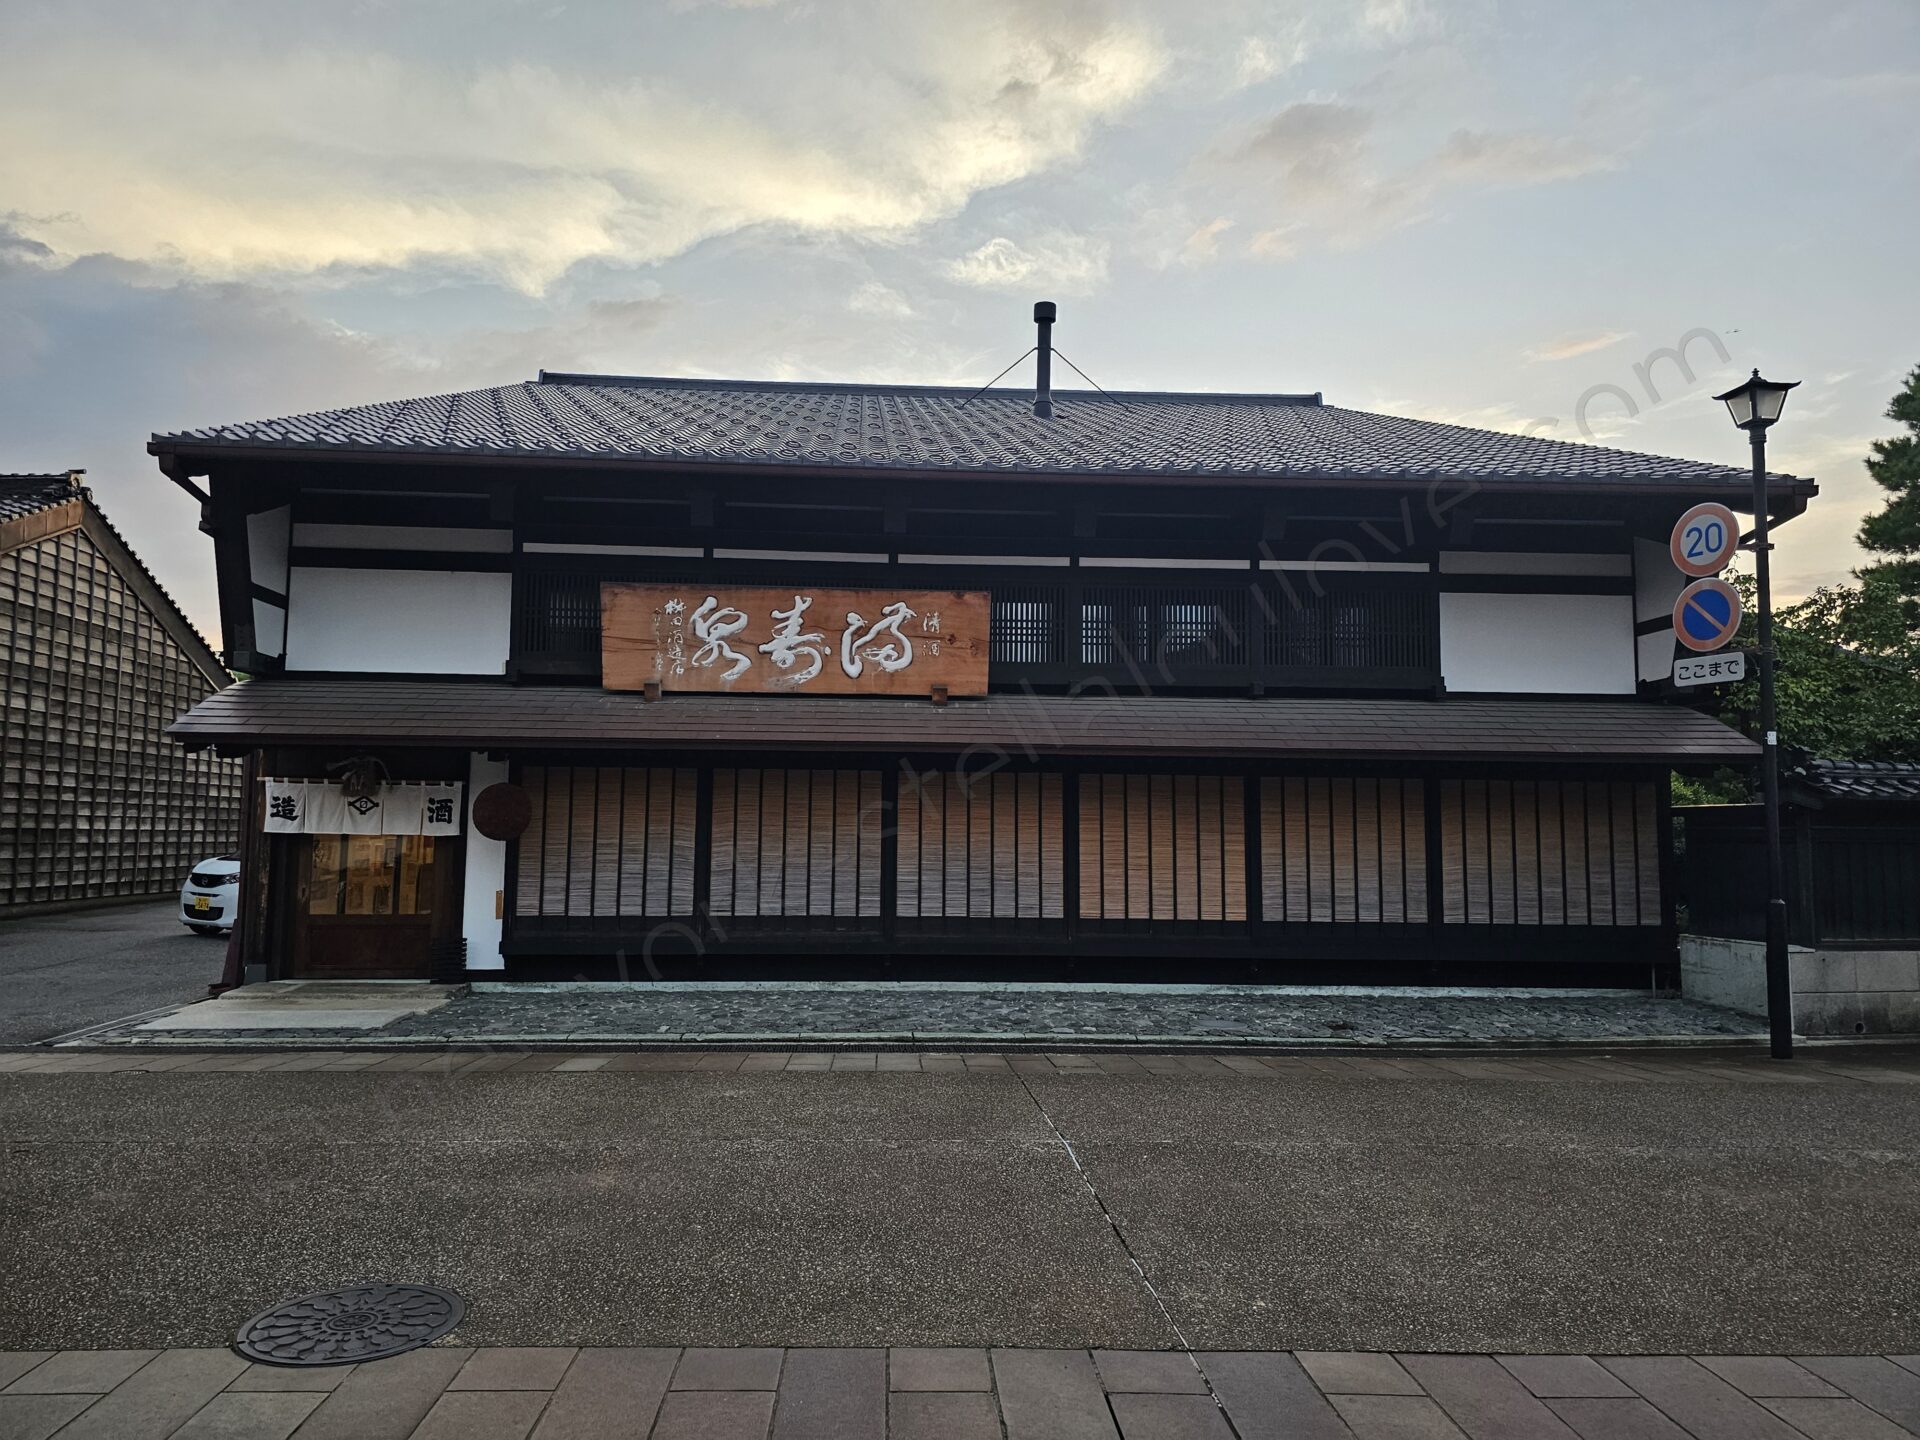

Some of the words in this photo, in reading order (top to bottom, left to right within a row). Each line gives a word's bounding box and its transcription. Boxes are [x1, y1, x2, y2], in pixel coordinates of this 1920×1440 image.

[1685, 522, 1723, 559] 20
[1678, 660, 1740, 680] ここまで
[270, 796, 299, 822] 造
[427, 797, 453, 824] 酒
